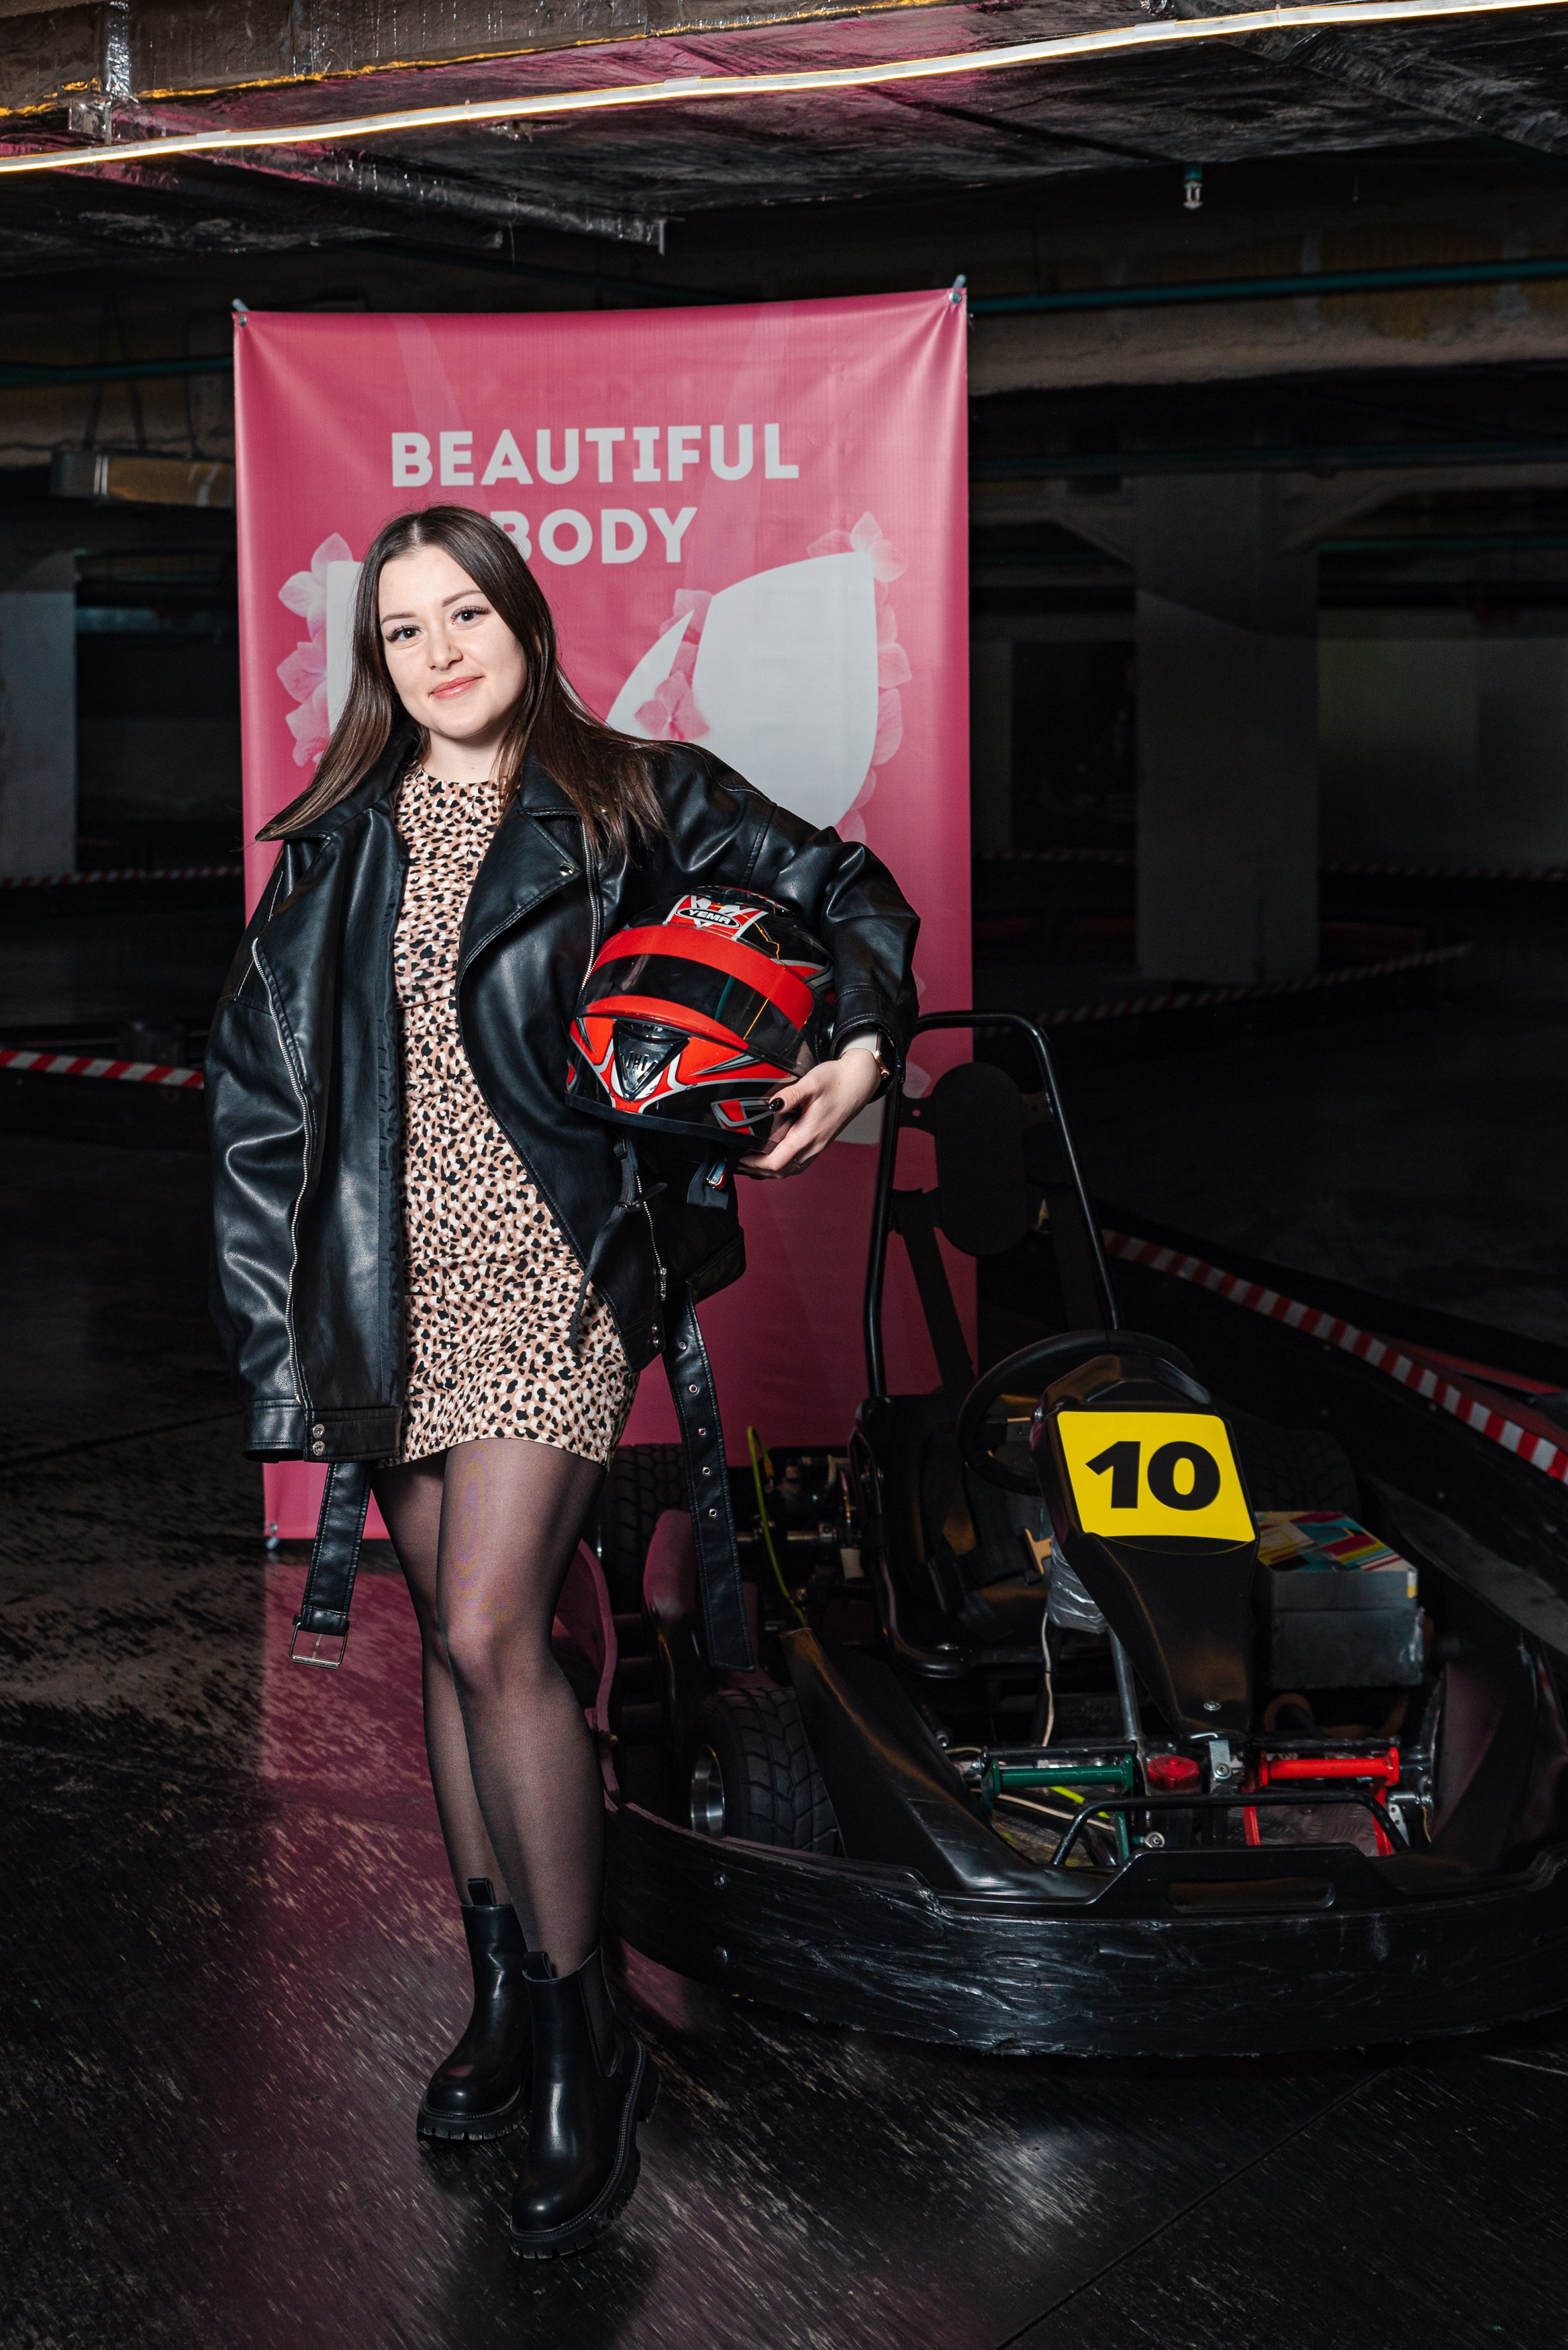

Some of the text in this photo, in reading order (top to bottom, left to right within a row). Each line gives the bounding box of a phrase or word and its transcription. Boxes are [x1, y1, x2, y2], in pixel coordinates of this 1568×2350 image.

[391, 423, 799, 487] BEAUTIFUL
[490, 507, 697, 566] BODY
[689, 909, 732, 925] YEMA
[1085, 1440, 1221, 1511] 10
